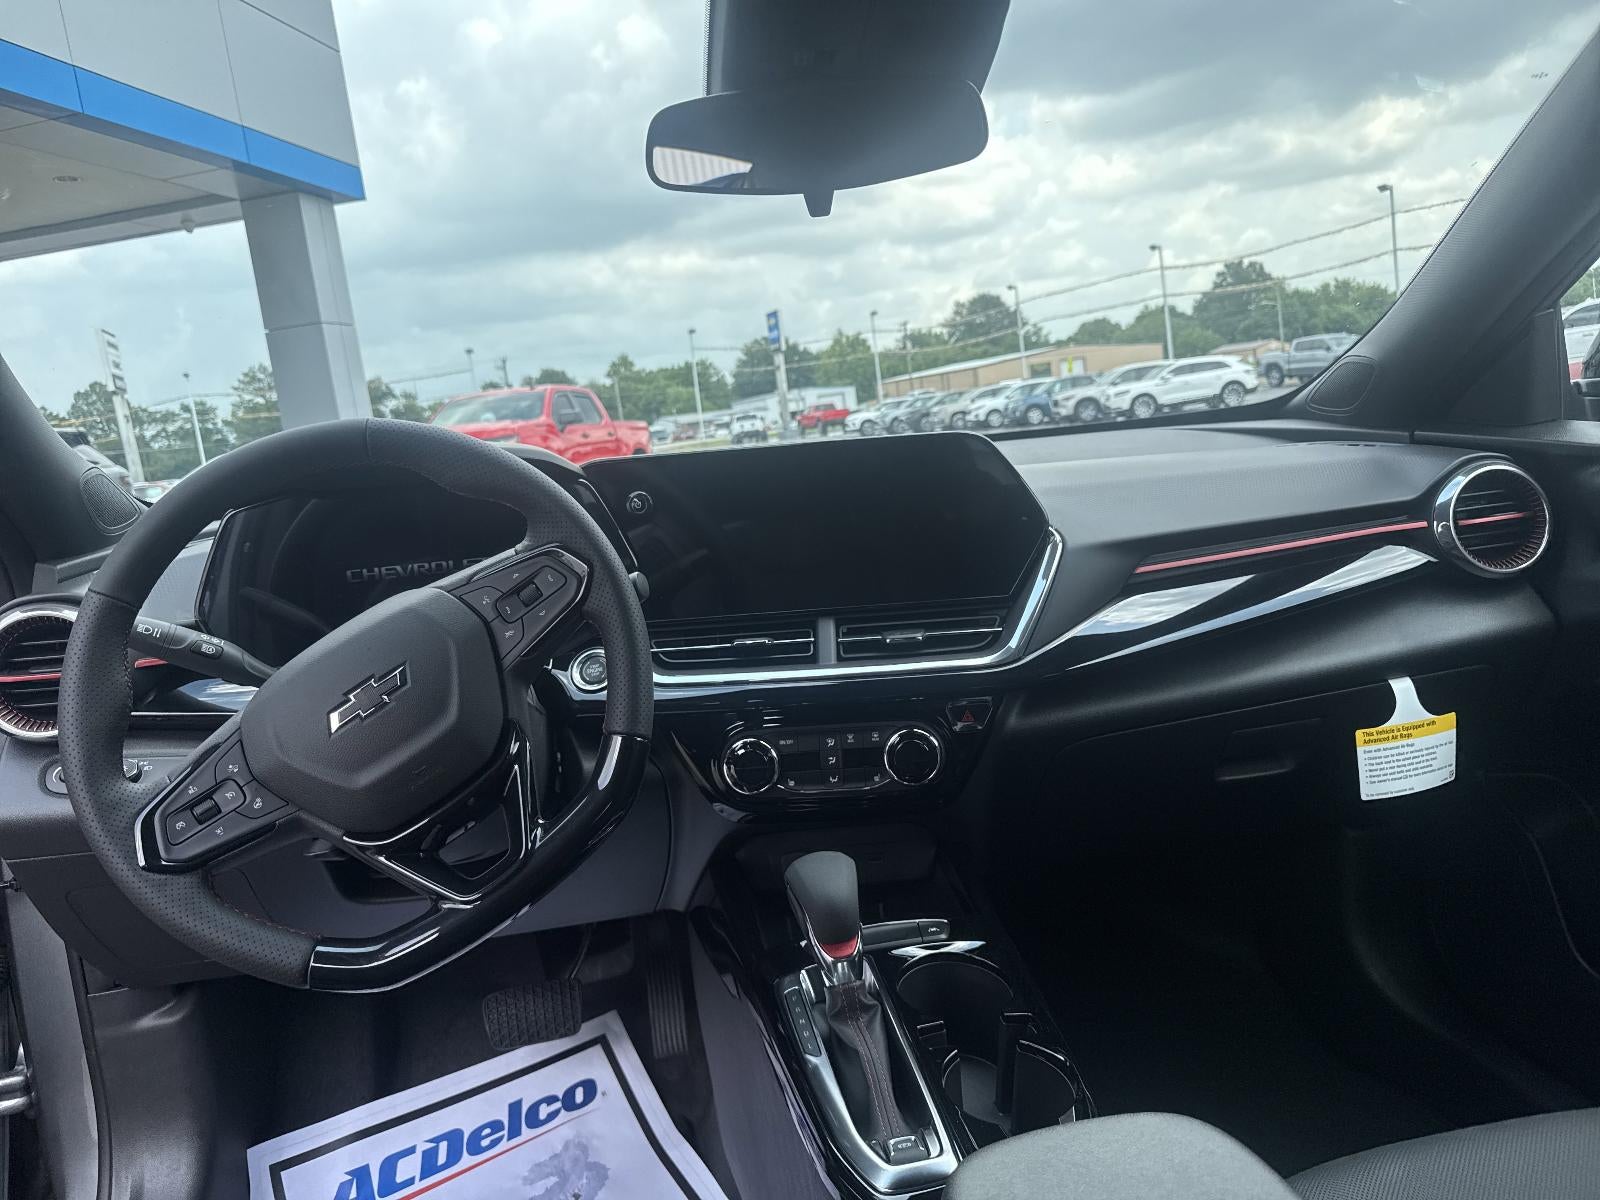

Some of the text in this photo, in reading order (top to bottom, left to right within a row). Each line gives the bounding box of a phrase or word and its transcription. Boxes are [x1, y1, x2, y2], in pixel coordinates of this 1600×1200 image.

[346, 557, 486, 583] CHEVRO
[1363, 731, 1413, 745] Advanced Air Bags
[1375, 728, 1395, 736] Vehicle
[1401, 722, 1425, 732] Equipped
[1426, 719, 1437, 727] with
[333, 1078, 598, 1200] ACDelco
